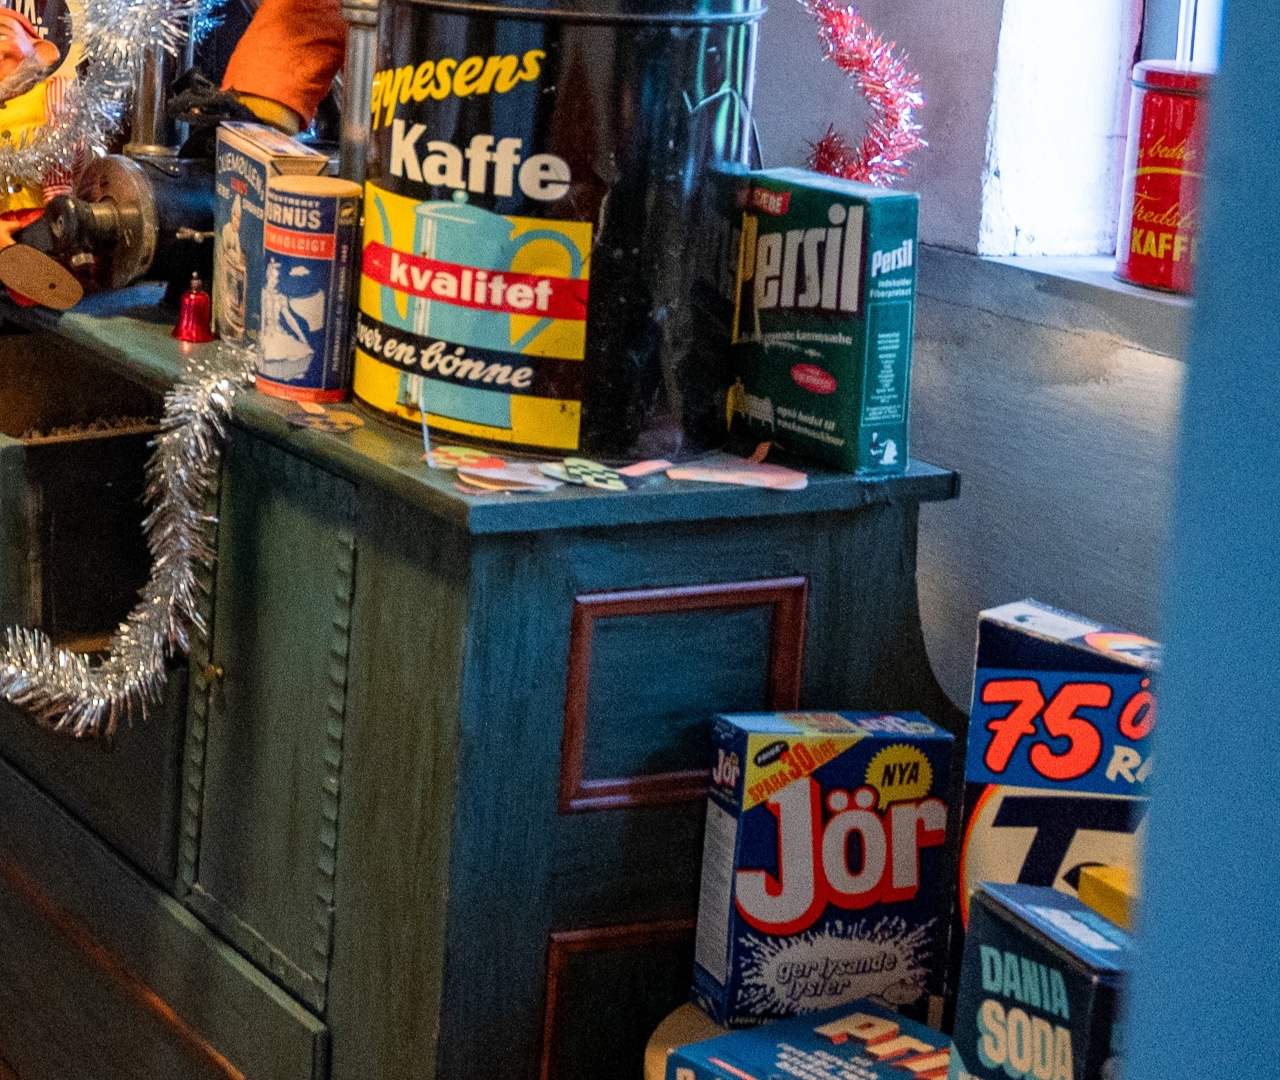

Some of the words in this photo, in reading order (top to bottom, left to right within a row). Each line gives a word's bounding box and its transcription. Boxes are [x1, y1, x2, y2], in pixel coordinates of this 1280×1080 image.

[389, 119, 572, 203] Kaffe
[388, 255, 554, 312] kvalitet
[870, 238, 914, 278] Persil
[383, 341, 417, 368] en
[980, 677, 1113, 782] 75
[713, 747, 739, 787] Jör
[881, 761, 920, 788] NYA
[735, 775, 949, 928] Jör
[979, 944, 1071, 1019] DANIA
[977, 998, 1076, 1080] SODA
